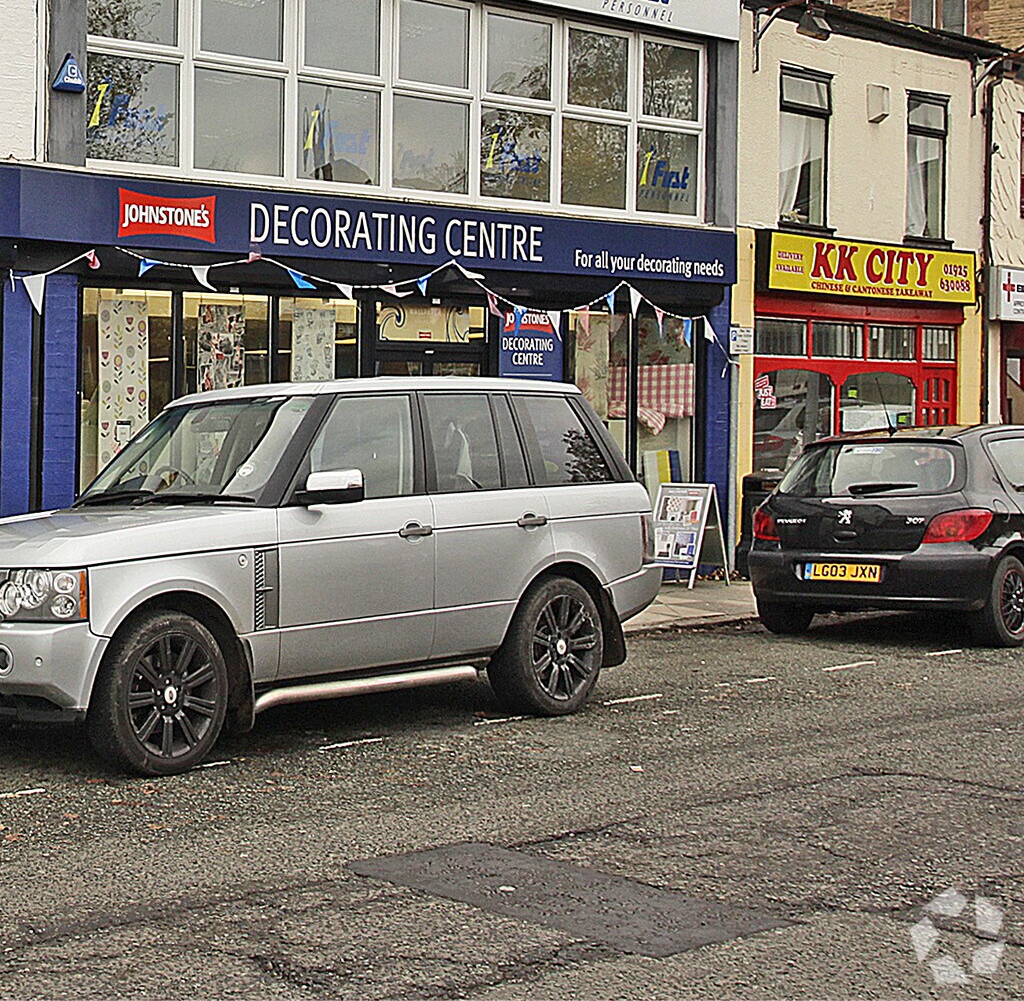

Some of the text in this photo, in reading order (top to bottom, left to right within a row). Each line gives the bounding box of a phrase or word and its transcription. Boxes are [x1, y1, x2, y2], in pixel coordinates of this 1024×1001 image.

[122, 204, 210, 228] JOHNSTONE'S
[249, 202, 543, 262] DECORATING CENTRE
[575, 249, 724, 278] For all your decorating needs
[811, 241, 934, 287] KK CITY
[943, 263, 968, 278] 01925
[811, 281, 844, 292] CHINESE
[852, 284, 894, 296] CANTONESE
[895, 288, 933, 298] TAKEAWAY
[939, 277, 971, 293] 630088
[502, 336, 553, 352] DECORATING
[512, 352, 544, 366] CENTRE
[813, 565, 878, 578] LG03 JXN
